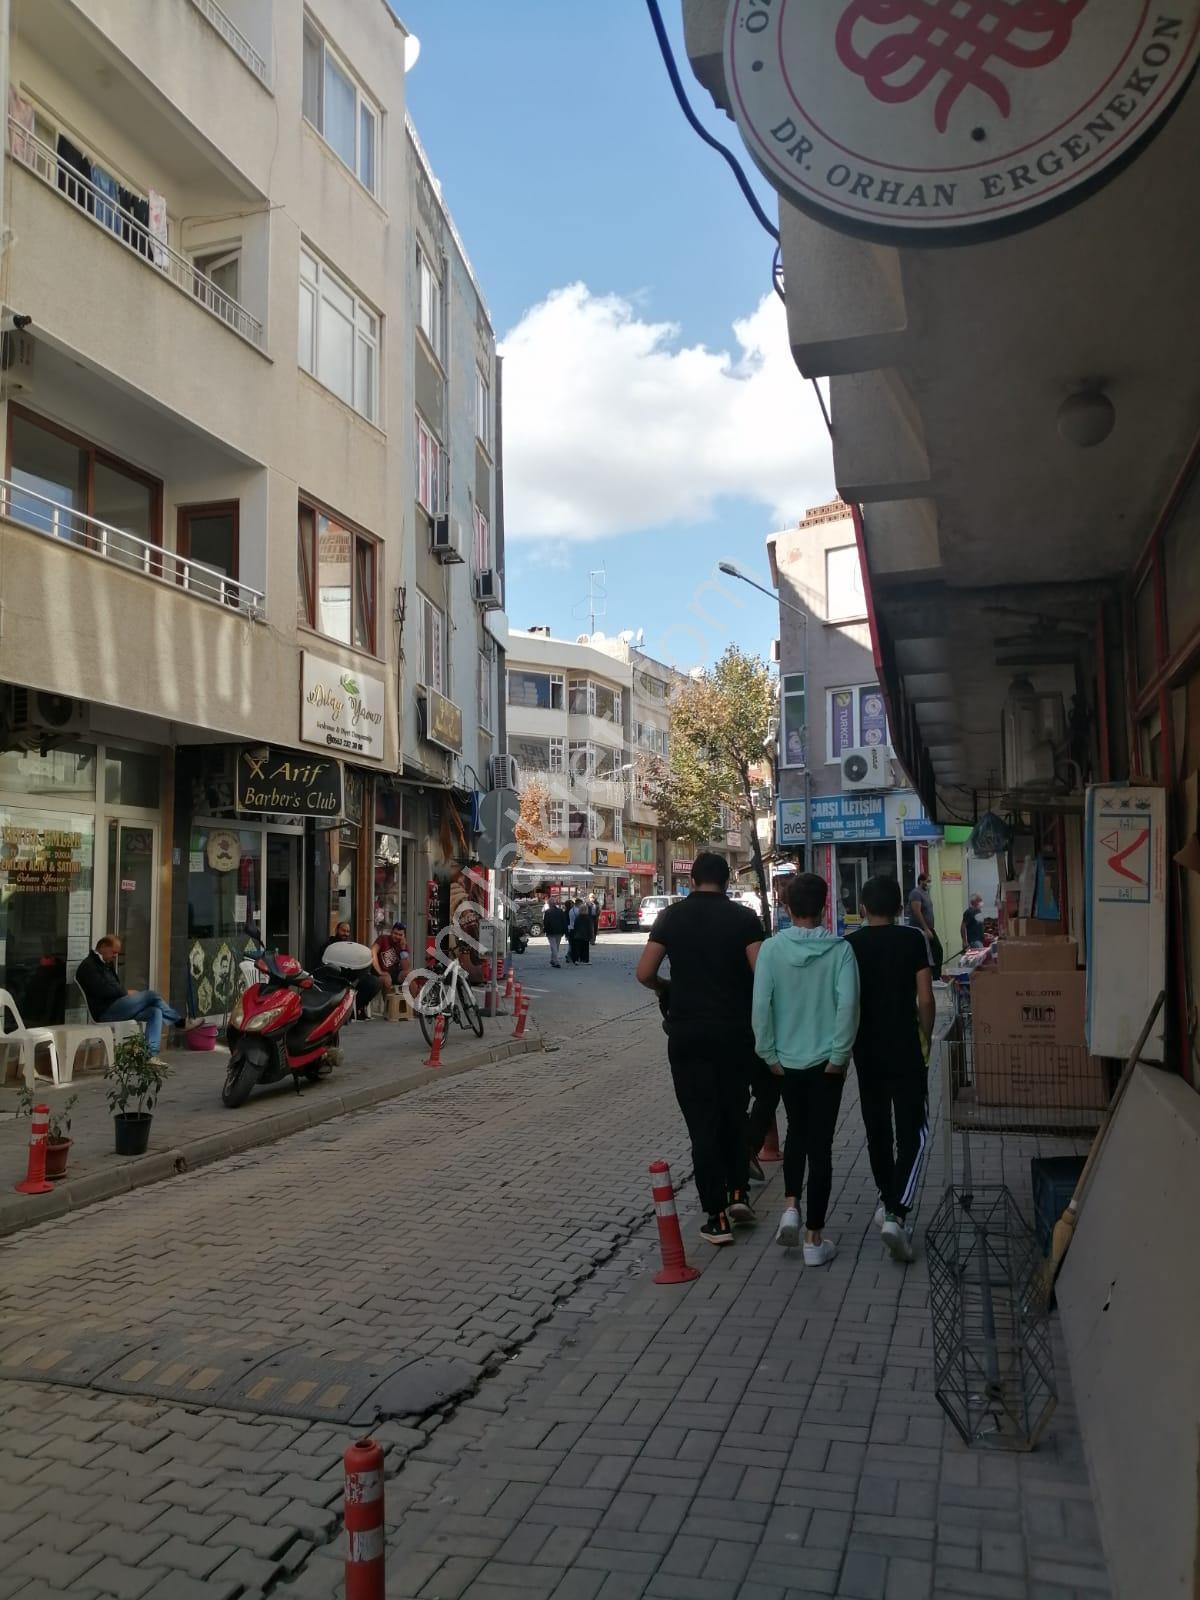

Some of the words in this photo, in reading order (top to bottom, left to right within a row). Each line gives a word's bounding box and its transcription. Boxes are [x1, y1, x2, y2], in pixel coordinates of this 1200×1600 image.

[770, 116, 813, 173] DR.
[826, 163, 957, 208] ORHAN
[980, 14, 1184, 201] ERGENEKON
[268, 762, 330, 788] Arif
[244, 787, 301, 808] Barber's
[306, 791, 336, 810] Club
[841, 796, 882, 817] İLETİŞİM
[783, 822, 808, 835] avea
